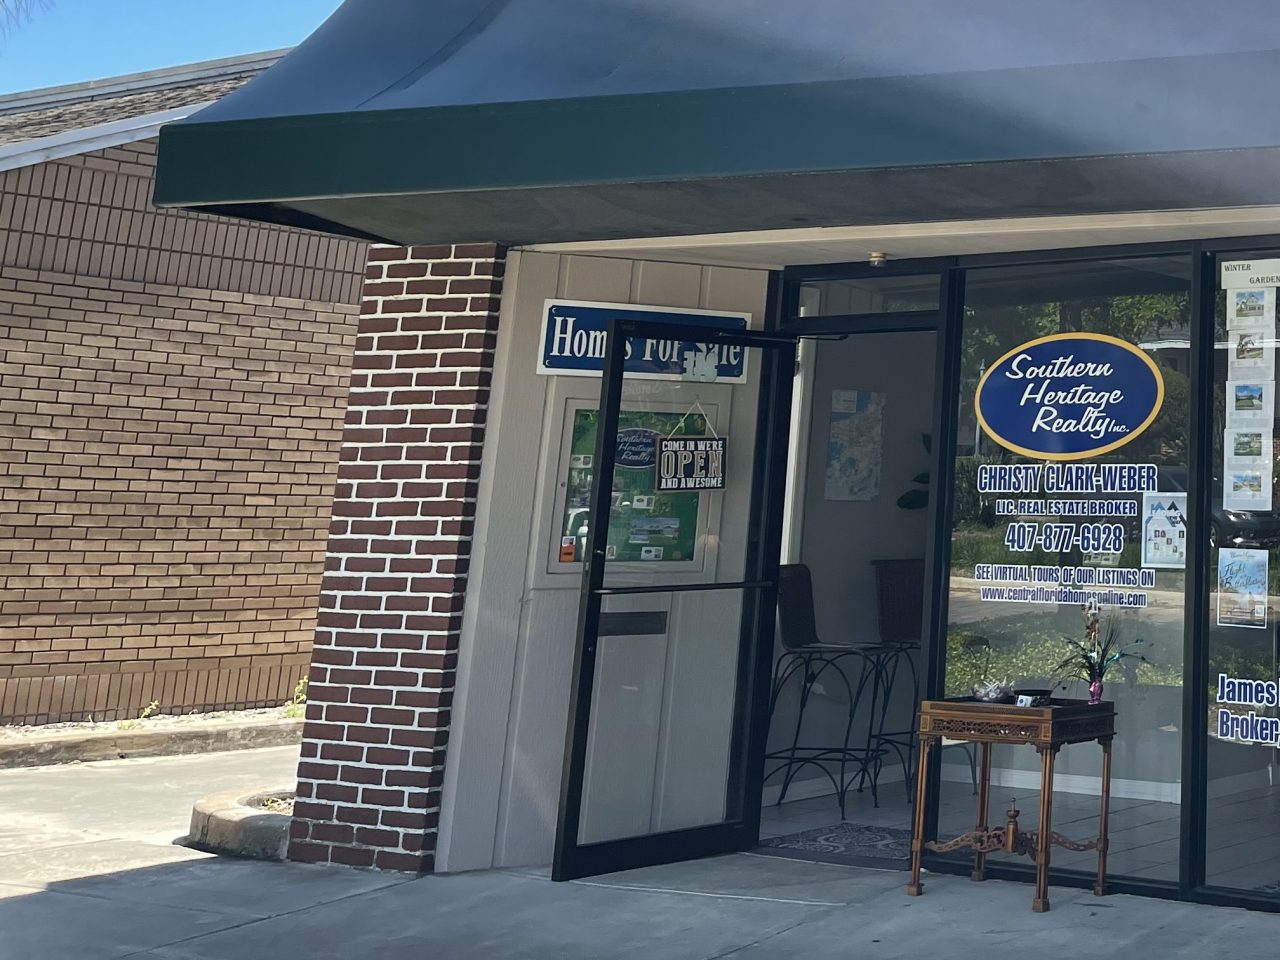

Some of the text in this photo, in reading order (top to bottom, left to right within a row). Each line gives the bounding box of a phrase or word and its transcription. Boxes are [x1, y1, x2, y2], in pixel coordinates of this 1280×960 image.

[1224, 263, 1251, 272] WINTER
[1249, 275, 1280, 284] GARDEN
[550, 316, 633, 360] Homs
[1005, 353, 1114, 380] Southern
[1019, 379, 1124, 411] Heritage
[1031, 406, 1130, 440] Realty Inc.
[662, 440, 685, 451] COME
[686, 440, 695, 451] IN
[661, 450, 723, 479] OPEN
[977, 463, 1158, 493] CHRISTY CLARK-WEBER
[660, 477, 723, 489] AND AWESOME
[996, 500, 1138, 517] LIC. REAL ESTATE BROKER
[1005, 522, 1125, 554] 407-877-6928
[975, 564, 1156, 588] SEE VIRTUAL TOURS OF OUR LISTINGS ON
[1217, 674, 1276, 706] James
